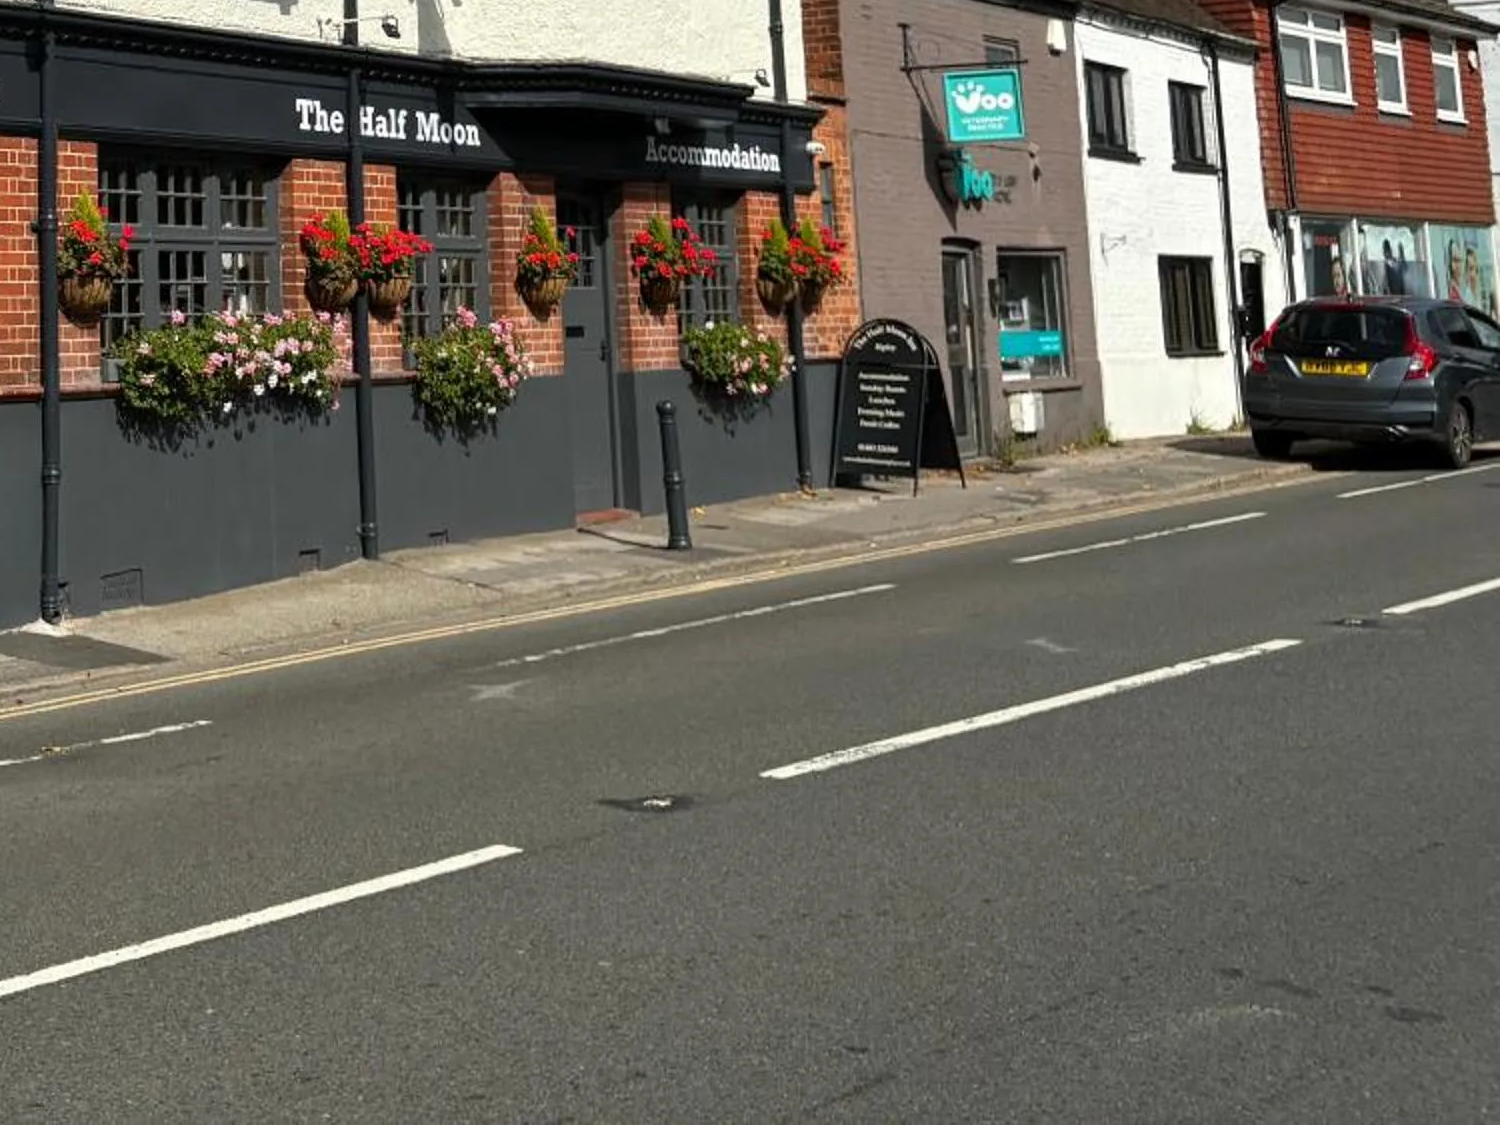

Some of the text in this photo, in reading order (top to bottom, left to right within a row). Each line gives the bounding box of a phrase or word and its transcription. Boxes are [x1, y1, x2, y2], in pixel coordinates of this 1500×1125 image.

[295, 98, 481, 147] The Half Moon
[645, 136, 781, 172] Accommodation
